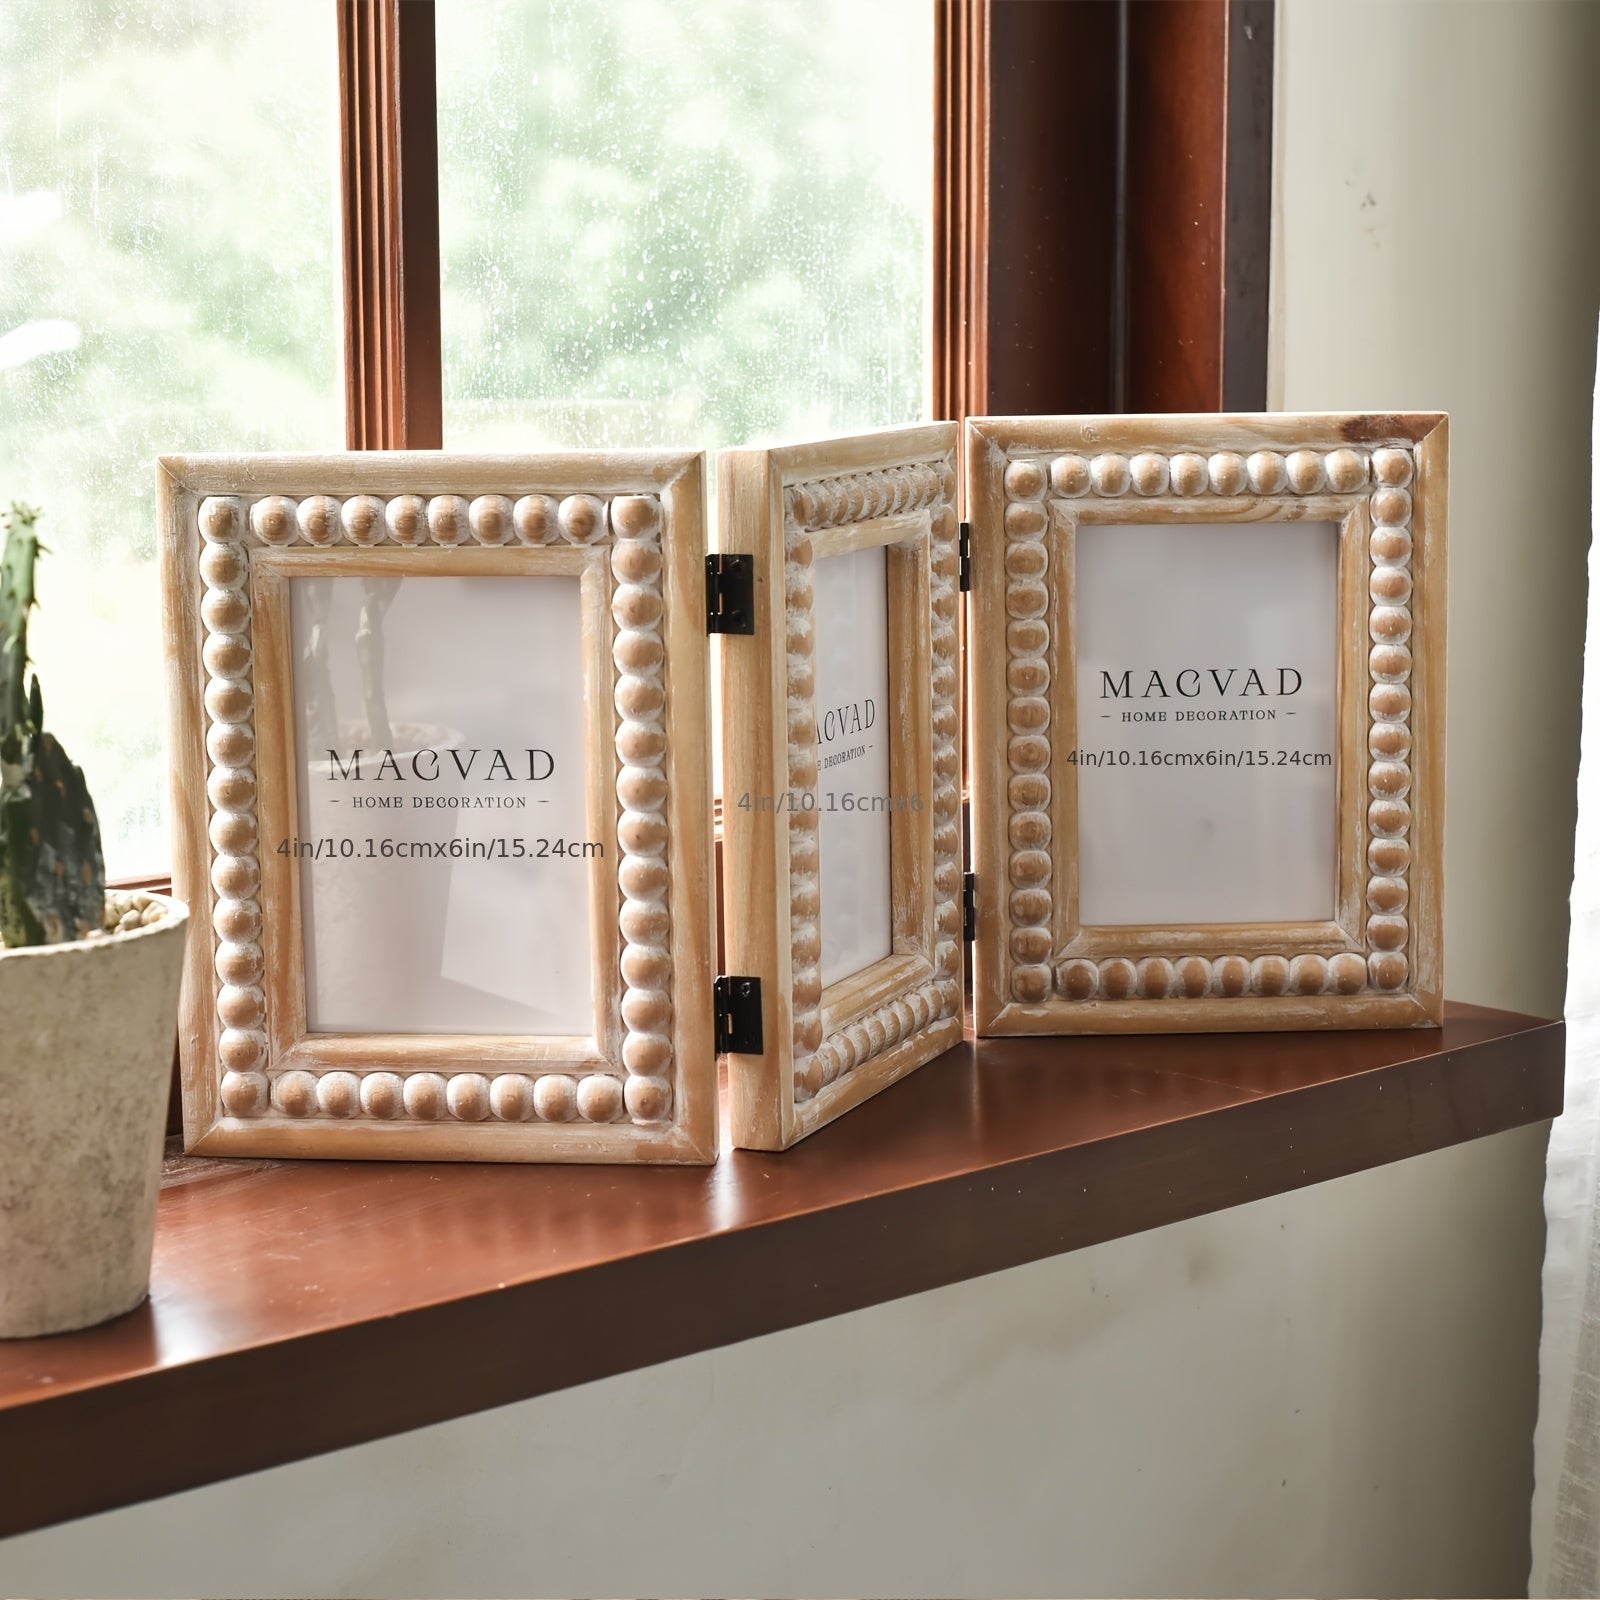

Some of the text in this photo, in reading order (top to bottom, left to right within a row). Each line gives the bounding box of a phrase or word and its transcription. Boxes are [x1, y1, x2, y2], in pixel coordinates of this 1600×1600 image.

[1099, 667, 1303, 699] MACVAD
[1121, 709, 1277, 722] HOME DECORATION
[326, 749, 555, 781] MACVAD
[824, 745, 866, 769] DECORATION
[352, 796, 527, 809] HOME DECORATION
